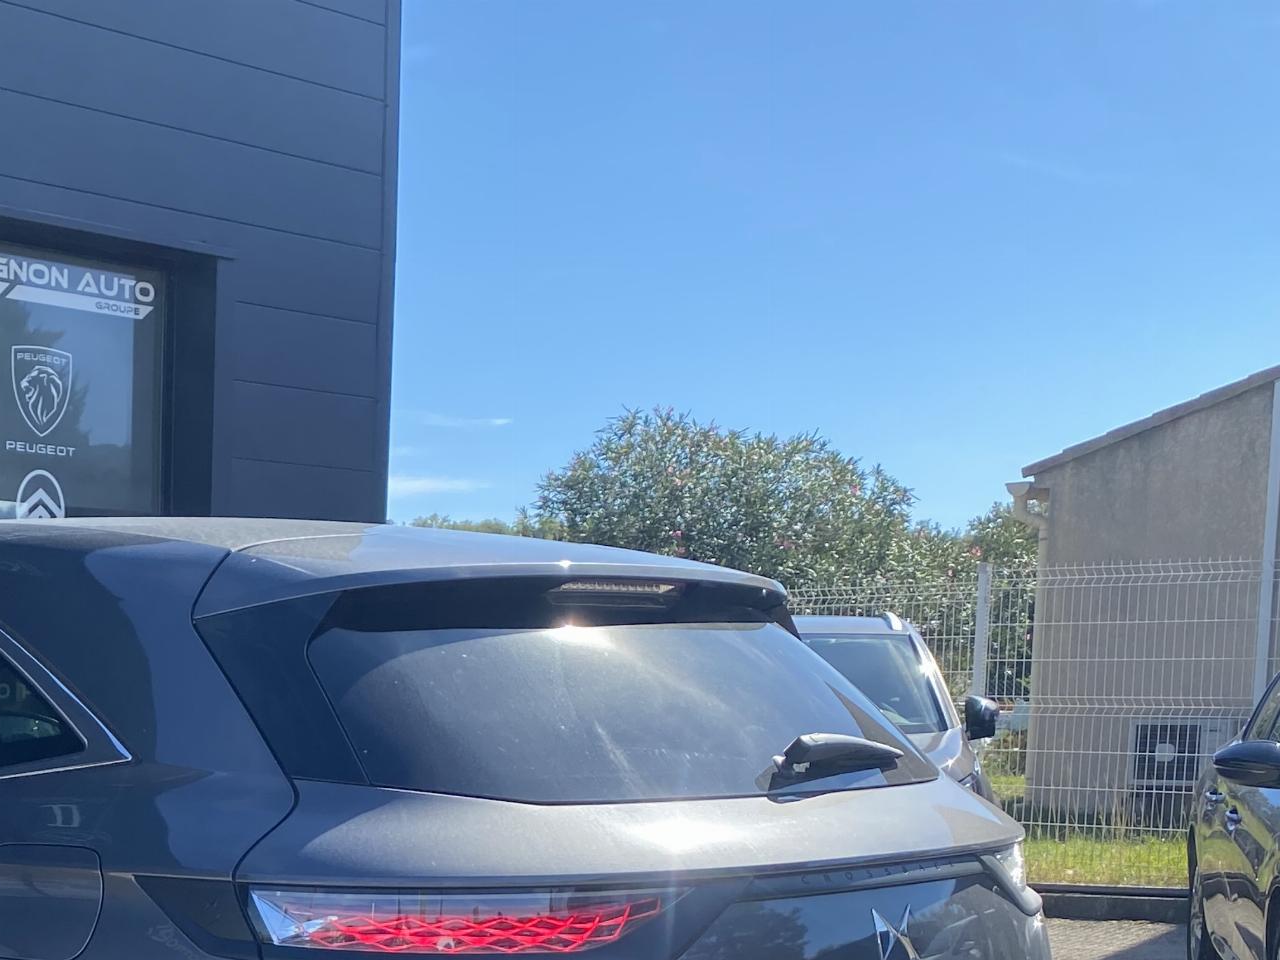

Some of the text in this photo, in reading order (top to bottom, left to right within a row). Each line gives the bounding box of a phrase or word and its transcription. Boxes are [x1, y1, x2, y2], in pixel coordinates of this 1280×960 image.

[76, 273, 155, 303] AUTO
[95, 300, 141, 316] GROUPE
[16, 351, 68, 365] PEUGEOT
[6, 440, 76, 457] PEUGEOT
